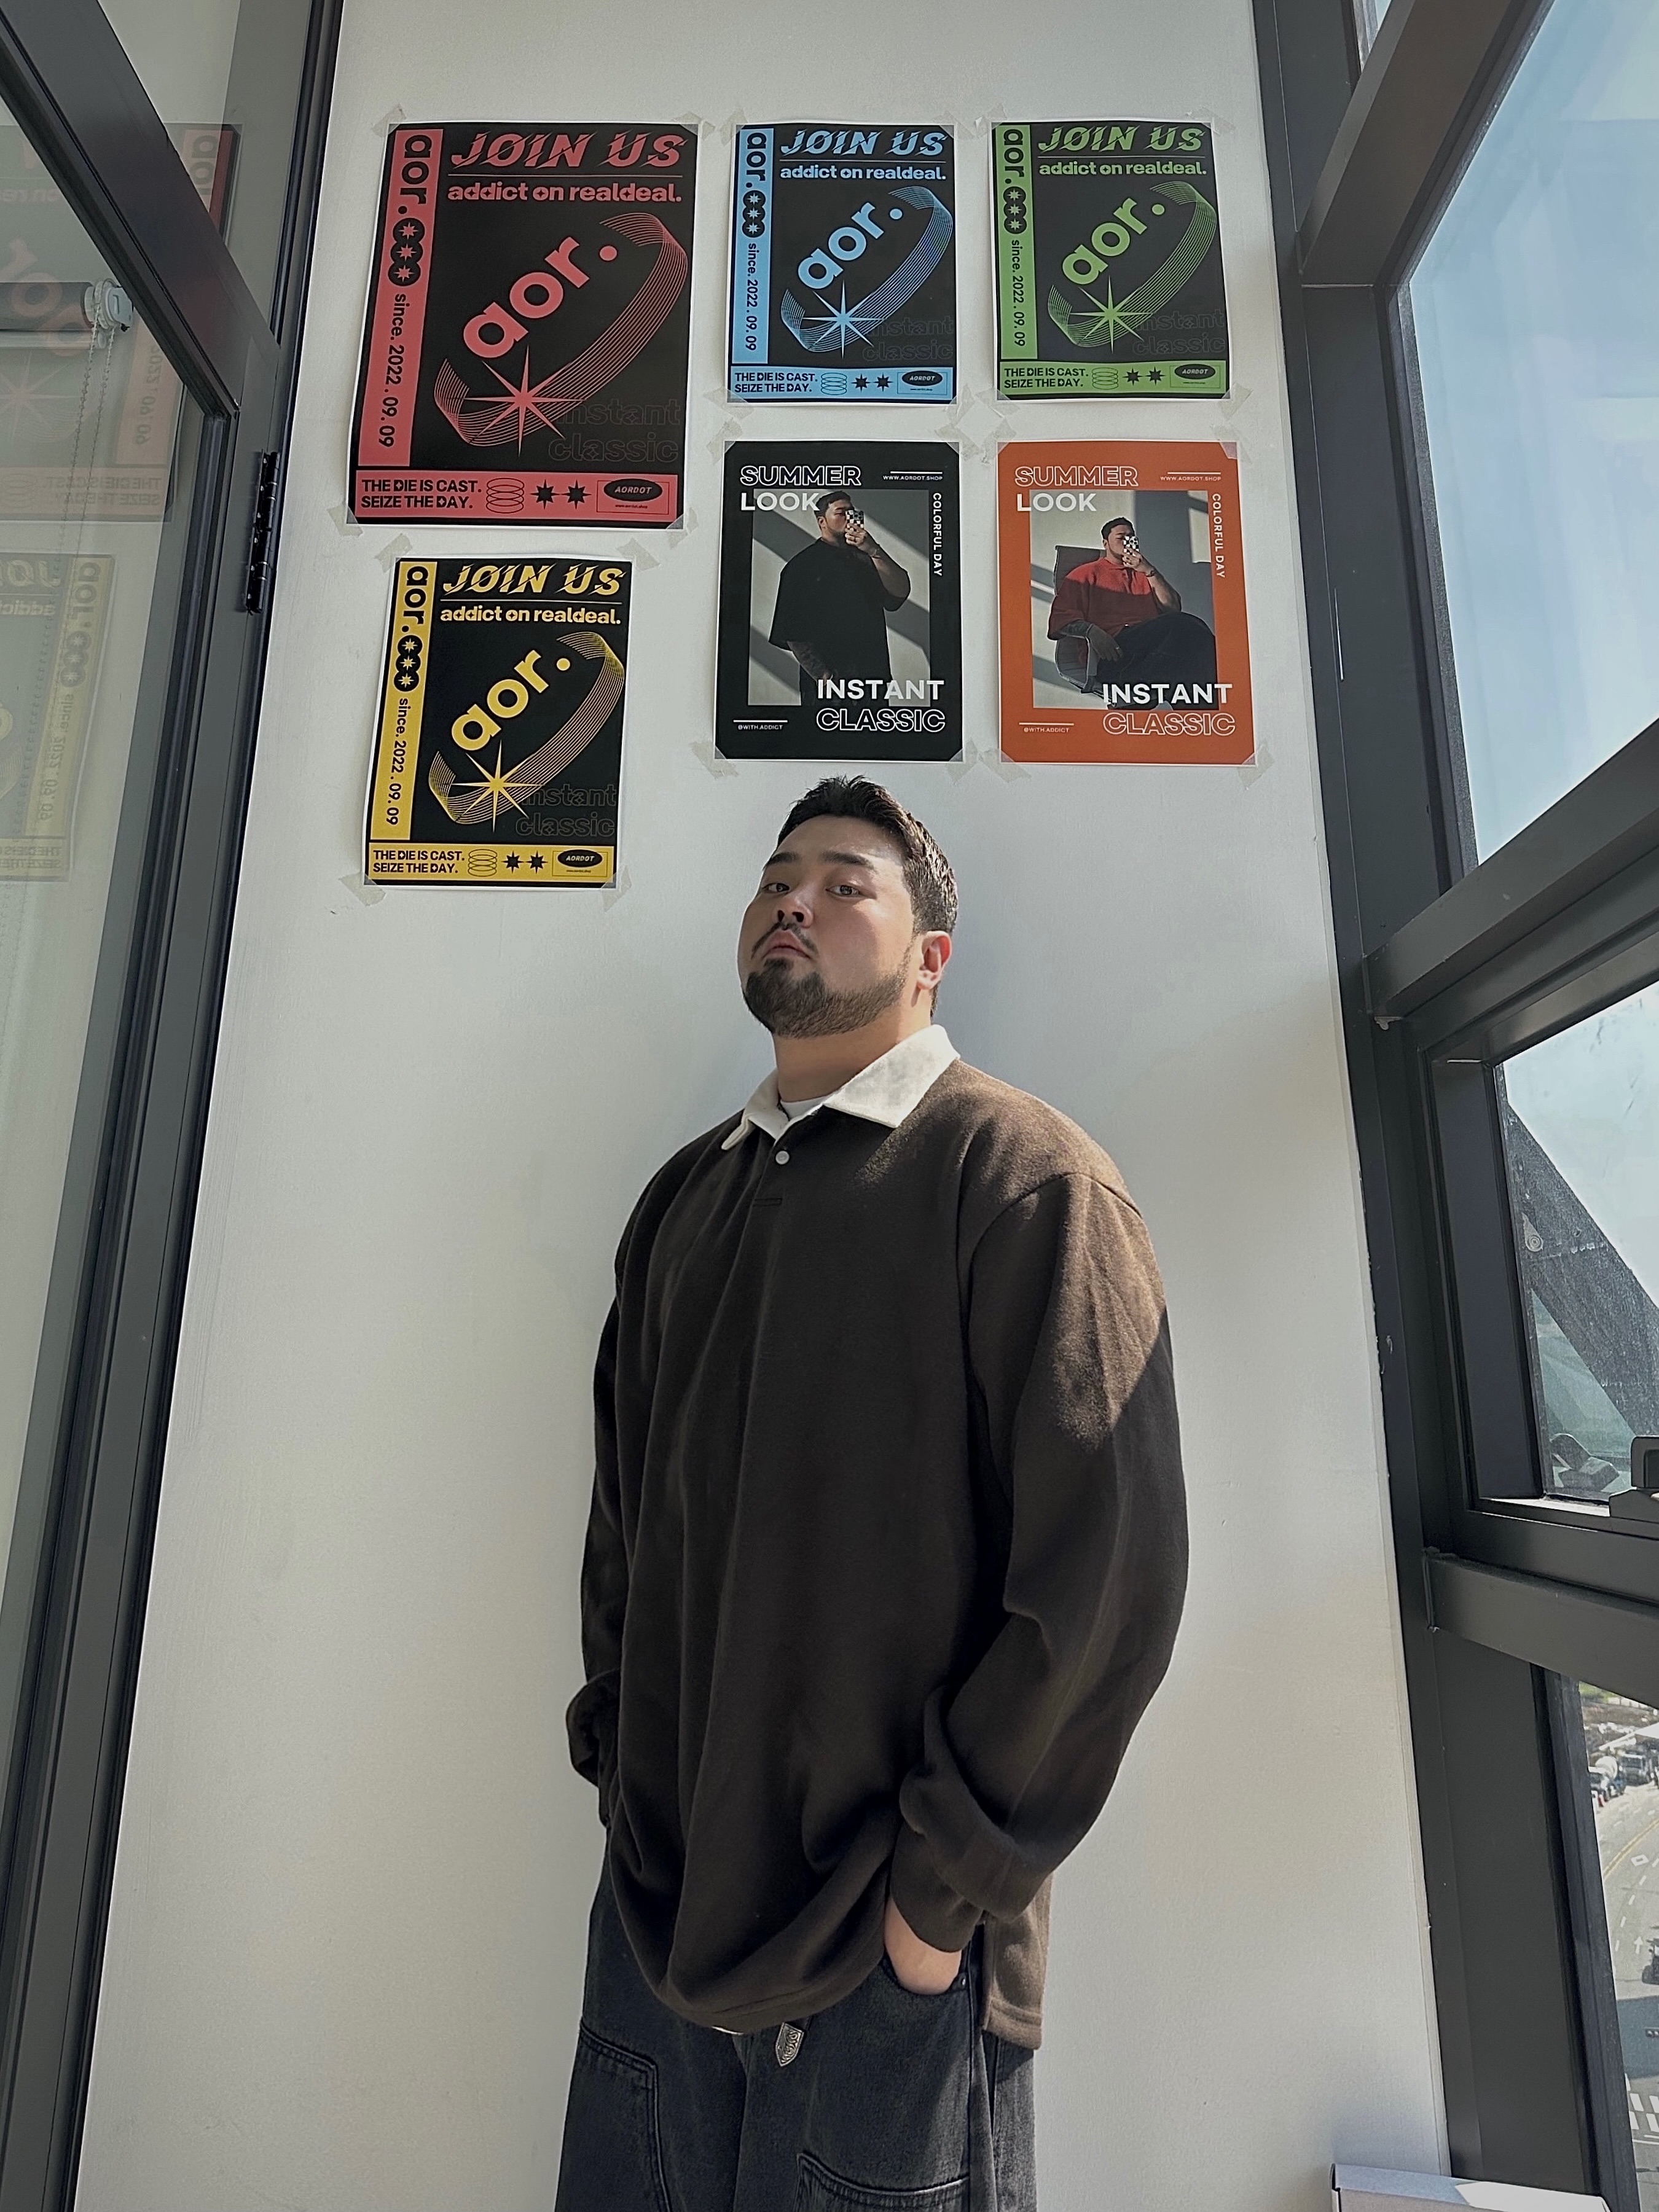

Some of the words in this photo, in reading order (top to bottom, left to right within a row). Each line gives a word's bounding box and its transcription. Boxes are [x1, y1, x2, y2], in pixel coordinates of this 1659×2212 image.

[451, 130, 598, 170] JOIN
[598, 130, 689, 168] US
[781, 130, 883, 156] JOIN
[884, 130, 947, 156] US
[1038, 125, 1140, 153] JOIN
[1144, 125, 1206, 152] US
[780, 165, 837, 179] addict
[841, 168, 863, 179] on
[866, 166, 946, 180] realdeal.
[1039, 161, 1096, 175] addict
[1100, 164, 1123, 175] on
[1126, 161, 1207, 175] realdeal.
[447, 181, 527, 201] addict
[532, 186, 564, 201] on
[569, 182, 682, 203] realdeal.
[748, 243, 759, 276] since.
[1011, 240, 1023, 272] since.
[747, 279, 758, 307] 2022
[1013, 276, 1024, 303] 2022
[390, 294, 410, 340] since.
[862, 339, 954, 362] classic
[1132, 332, 1226, 356] classic
[385, 345, 405, 385] 2022
[1004, 368, 1025, 377] THE
[1027, 368, 1043, 377] DIE
[1057, 368, 1089, 377] CAST.
[735, 373, 755, 381] THE
[786, 373, 818, 381] CAST.
[735, 383, 763, 393] SEIZE
[765, 383, 785, 392] THE
[786, 383, 812, 392] DAY.
[1004, 379, 1033, 388] SEIZE
[1035, 378, 1056, 387] THE
[1057, 378, 1084, 387] DAY.
[548, 432, 678, 463] classic
[361, 479, 391, 493] THE
[393, 479, 417, 492] DIE
[420, 479, 433, 492] IS
[436, 480, 482, 493] CAST.
[740, 466, 861, 487] SUMMER
[1015, 466, 1139, 487] SUMMER
[614, 486, 653, 494] AORDOT
[741, 491, 820, 512] LOOK
[361, 495, 401, 509] SEIZE
[404, 495, 433, 508] THE
[436, 496, 473, 509] DAY.
[1016, 493, 1097, 512] LOOK
[933, 493, 942, 551] COLORFUL
[1212, 493, 1223, 552] COLORFUL
[933, 553, 943, 576] DAY
[1215, 555, 1226, 578] DAY
[443, 563, 556, 595] JOIN
[555, 563, 627, 595] US
[440, 605, 503, 622] addict
[506, 609, 530, 622] on
[534, 607, 621, 625] realdeal.
[817, 679, 944, 700] INSTANT
[1103, 683, 1232, 705] INSTANT
[395, 698, 411, 737] since.
[816, 708, 946, 733] CLASSIC
[1103, 712, 1236, 737] CLASSIC
[391, 740, 407, 773] 2022
[516, 811, 614, 837] classic
[373, 850, 396, 860] THE
[398, 850, 415, 860] DIE
[418, 851, 428, 860] IS
[430, 851, 465, 861] CAST.
[373, 862, 404, 872] SEIZE
[406, 863, 428, 873] THE
[431, 863, 458, 873] DAY.
